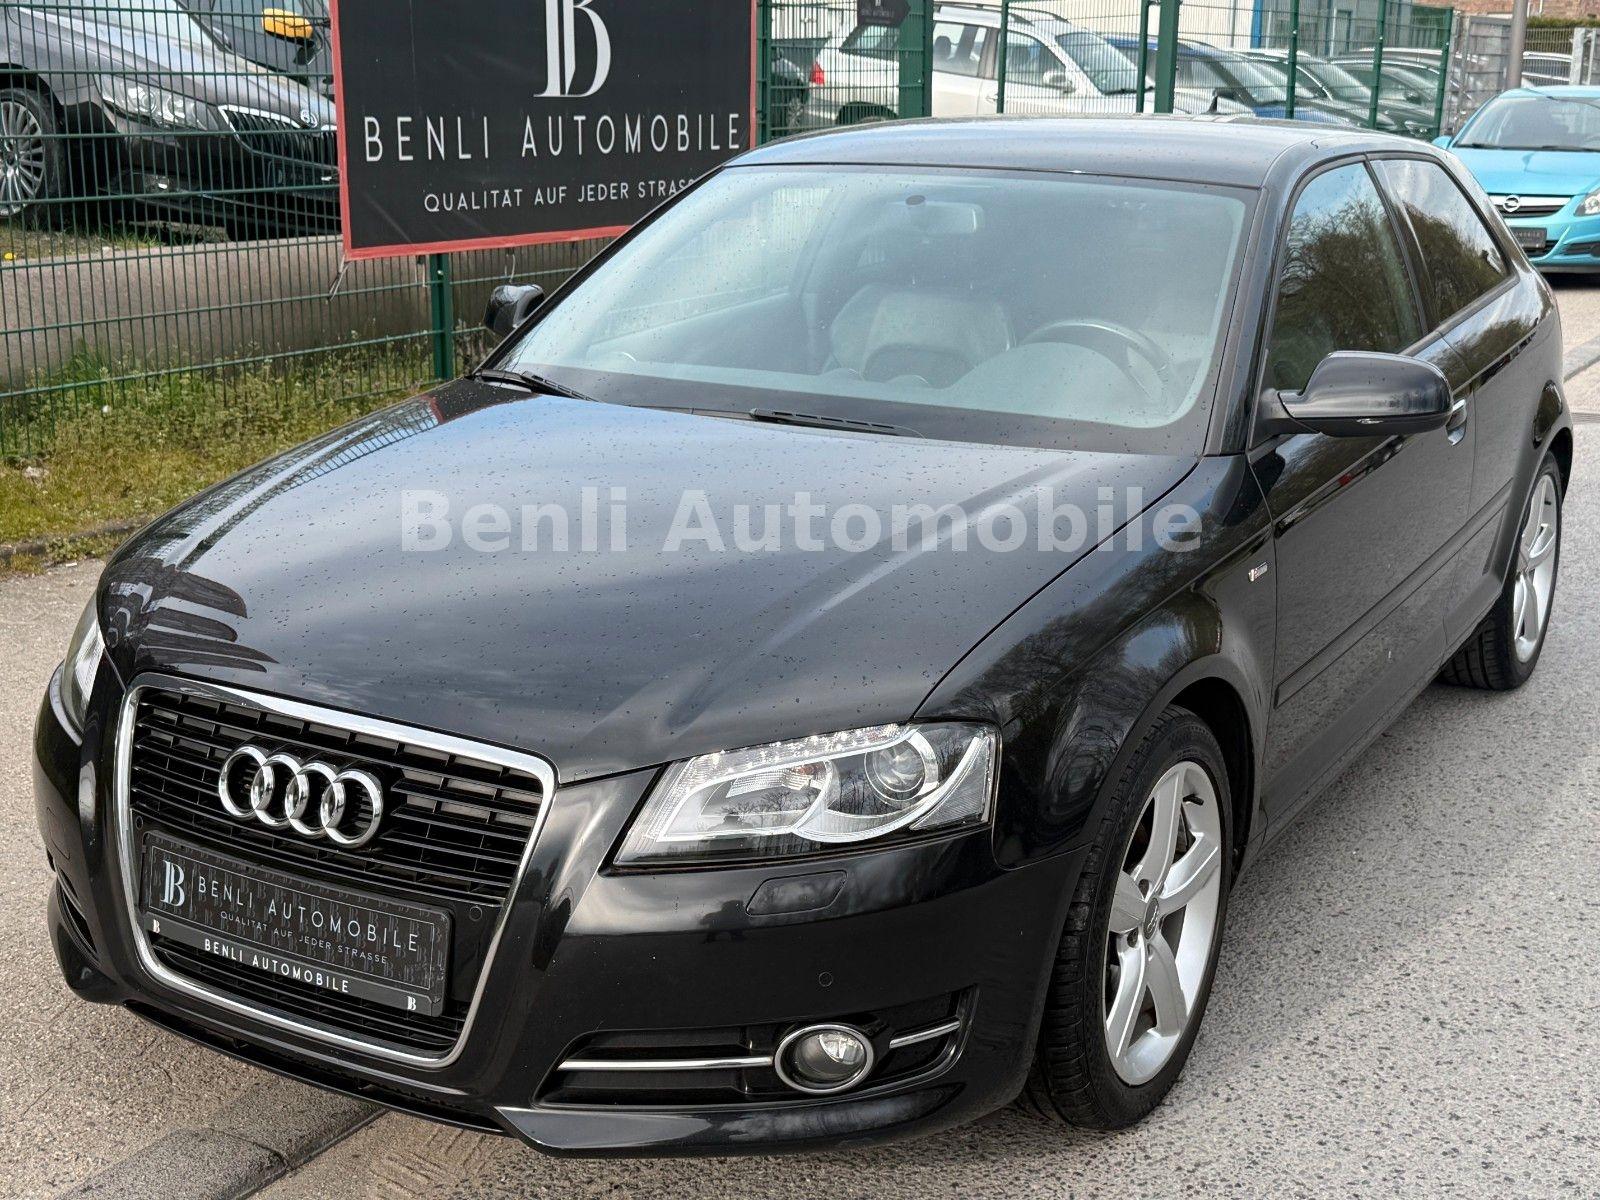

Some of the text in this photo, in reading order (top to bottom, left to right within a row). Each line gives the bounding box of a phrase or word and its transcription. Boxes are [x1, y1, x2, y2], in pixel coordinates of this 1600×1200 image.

[364, 113, 740, 162] BENLI AUTOMOBILE
[424, 179, 694, 212] QUALITÄT AUF JEDER STRAS
[198, 876, 418, 952] BENLI AUTOMOBILE
[204, 938, 349, 993] BENLI AUTOMOBILE
[273, 927, 293, 939] AUF
[299, 935, 331, 950] JEDER
[337, 945, 388, 965] STRASSE
